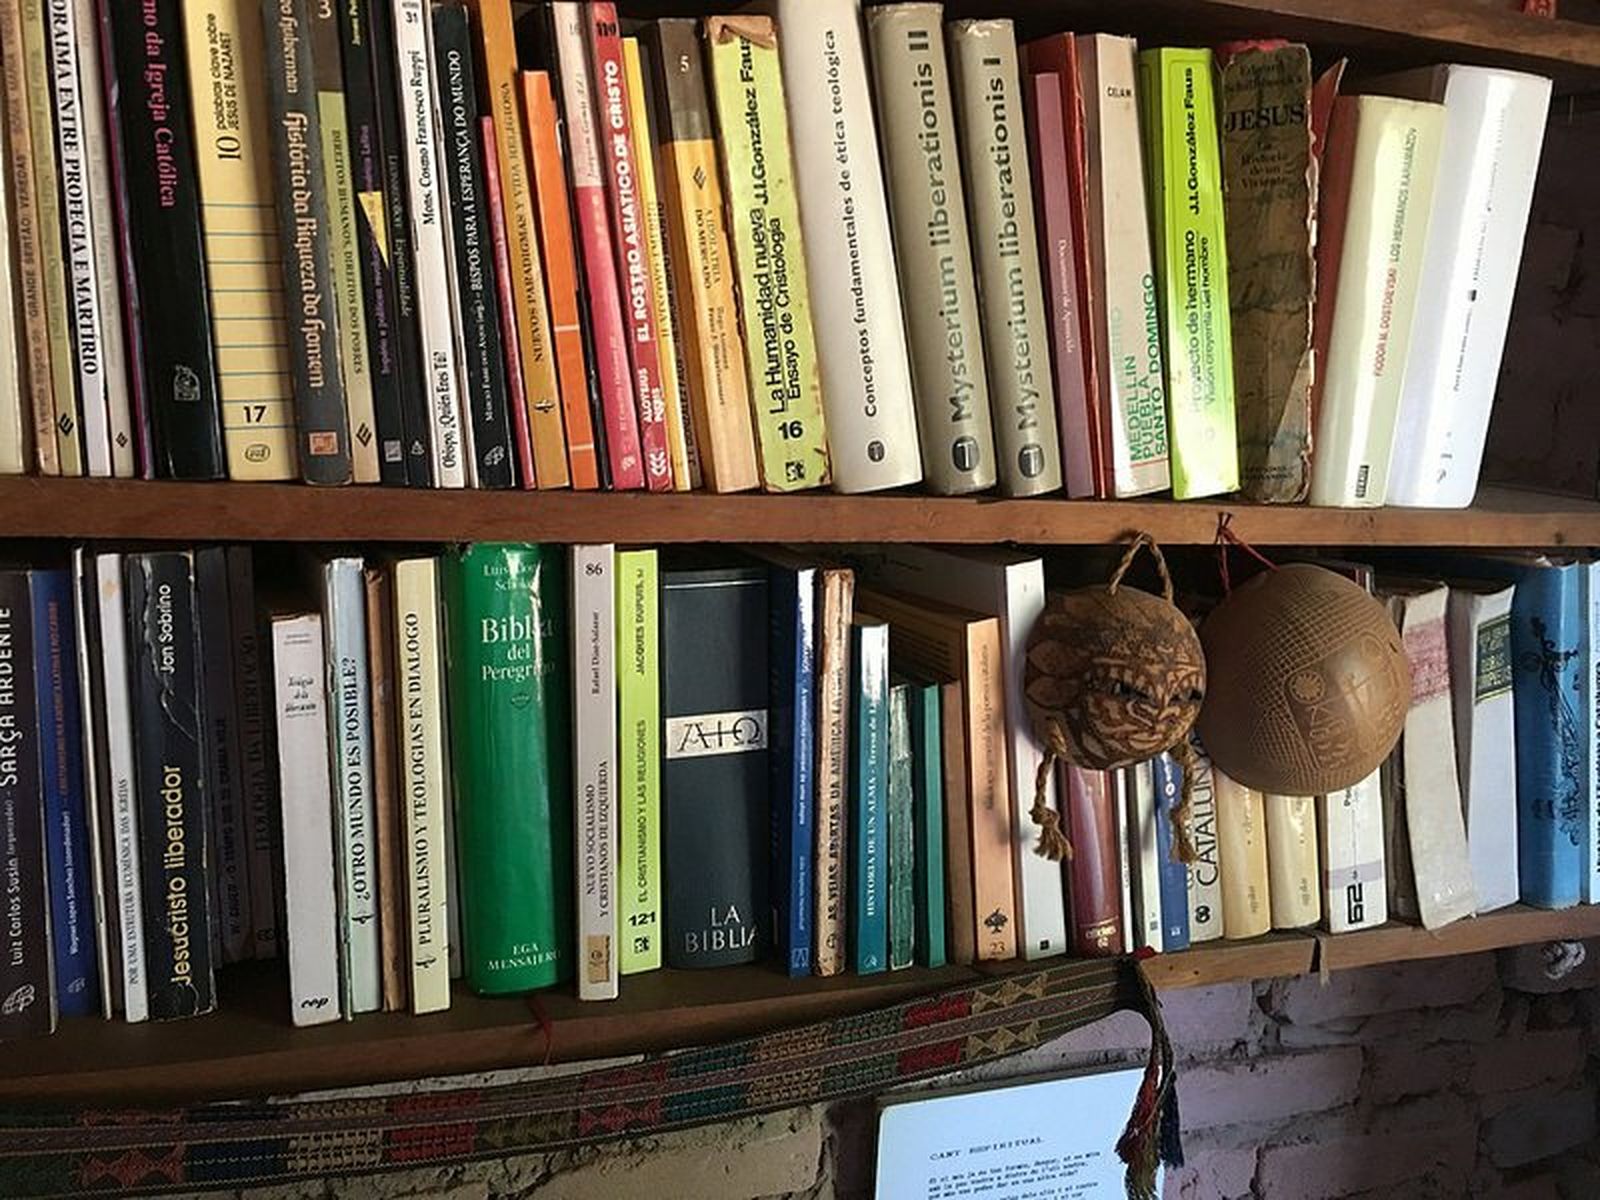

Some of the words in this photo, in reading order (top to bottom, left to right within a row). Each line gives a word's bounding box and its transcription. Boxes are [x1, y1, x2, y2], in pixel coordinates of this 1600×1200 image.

[145, 32, 164, 56] da
[206, 13, 218, 44] sobre
[907, 30, 929, 51] II
[209, 47, 220, 79] clave
[220, 32, 234, 81] NAZARET
[407, 50, 424, 87] Ruppi
[447, 50, 463, 101] MUNDO
[680, 55, 689, 72] 5
[823, 29, 844, 114] teológica
[982, 57, 1001, 66] I
[145, 63, 170, 121] Igreja
[212, 81, 226, 130] palabras
[224, 84, 236, 98] DE
[603, 60, 624, 129] CRISTO
[1183, 67, 1195, 109] Faus
[60, 87, 80, 153] ENTRE
[413, 89, 429, 145] Francesco
[452, 101, 465, 127] DO
[1224, 104, 1305, 132] JESUS
[215, 136, 241, 160] 10
[283, 112, 309, 188] História
[456, 130, 473, 201] ESPERANÇA
[612, 133, 627, 158] DE
[833, 120, 849, 164] ética
[913, 62, 951, 247] liberationis
[985, 77, 1019, 256] liberationis
[154, 127, 179, 207] Católica
[418, 148, 432, 188] Cosmo
[511, 163, 523, 199] VIDA
[839, 170, 852, 192] de
[65, 158, 87, 254] PROFECIA
[292, 190, 312, 213] da
[422, 192, 435, 225] Mons.
[464, 204, 476, 214] A
[514, 200, 524, 209] Y
[615, 159, 638, 246] ASIATICO
[293, 216, 318, 291] Riqueza
[464, 214, 479, 246] PARA
[749, 208, 768, 269] nueva
[74, 260, 89, 271] E
[343, 250, 359, 304] DIREITOS
[467, 249, 483, 290] BISPOS
[516, 210, 536, 304] PARADIGMAS
[697, 226, 712, 289] MERCADO
[769, 217, 791, 309] Cristología
[842, 197, 866, 324] fundamentales
[1184, 230, 1198, 309] hermano
[302, 293, 322, 315] do
[627, 252, 646, 320] ROSTRO
[76, 277, 99, 375] MARTÍRIO
[348, 307, 361, 329] DOS
[530, 307, 543, 363] NUEVOS
[636, 323, 650, 341] EL
[753, 273, 783, 384] Humanidad
[778, 312, 793, 334] de
[939, 255, 974, 423] Mysterium
[1142, 273, 1160, 374] DOMINGO
[1184, 312, 1198, 334] de
[784, 339, 801, 399] Ensayo
[857, 328, 877, 417] Conceptos
[1007, 267, 1039, 431] Mysterium
[436, 371, 449, 393] Eres
[1186, 337, 1204, 413] Proyecto
[243, 405, 266, 423] 17
[769, 389, 787, 414] La
[1124, 355, 1144, 461] MEDELLIN
[1138, 375, 1154, 459] PUEBLA
[1151, 386, 1166, 455] SANTO
[778, 421, 803, 440] 16
[585, 561, 603, 576] 86
[156, 584, 173, 642] Sobrino
[0, 607, 16, 706] ARDENTE
[403, 613, 422, 694] DIALOGO
[507, 643, 531, 661] del
[635, 626, 645, 676] JACQUES
[341, 658, 360, 742] POSIBLE?
[408, 697, 423, 719] EN
[0, 714, 23, 787] SARÇA
[346, 745, 360, 766] ES
[409, 723, 427, 816] TEOLOGIAS
[636, 719, 646, 782] RELIGIONES
[348, 771, 365, 838] MUNDO
[597, 760, 610, 823] IZQUIERDA
[636, 783, 646, 804] LAS
[637, 806, 647, 814] Y
[830, 780, 840, 798] DA
[867, 779, 877, 814] ALMA
[160, 765, 185, 868] liberador
[414, 823, 427, 837] Y
[585, 784, 596, 855] SOCIALISMO
[598, 825, 608, 840] DE
[866, 819, 877, 836] UN
[351, 839, 371, 901] ¿OTRO
[637, 815, 648, 887] CRISTIANISMO
[865, 839, 876, 856] DE
[5, 858, 20, 894] Susin
[415, 838, 432, 944] PLURALISMO
[586, 856, 597, 895] NUEVO
[598, 841, 609, 908] CRISTIANOS
[638, 888, 648, 903] EL
[8, 896, 22, 938] Carlos
[167, 876, 191, 985] Jesucristo
[628, 911, 656, 926] 121
[710, 905, 740, 927] LA
[11, 940, 25, 965] Luiz
